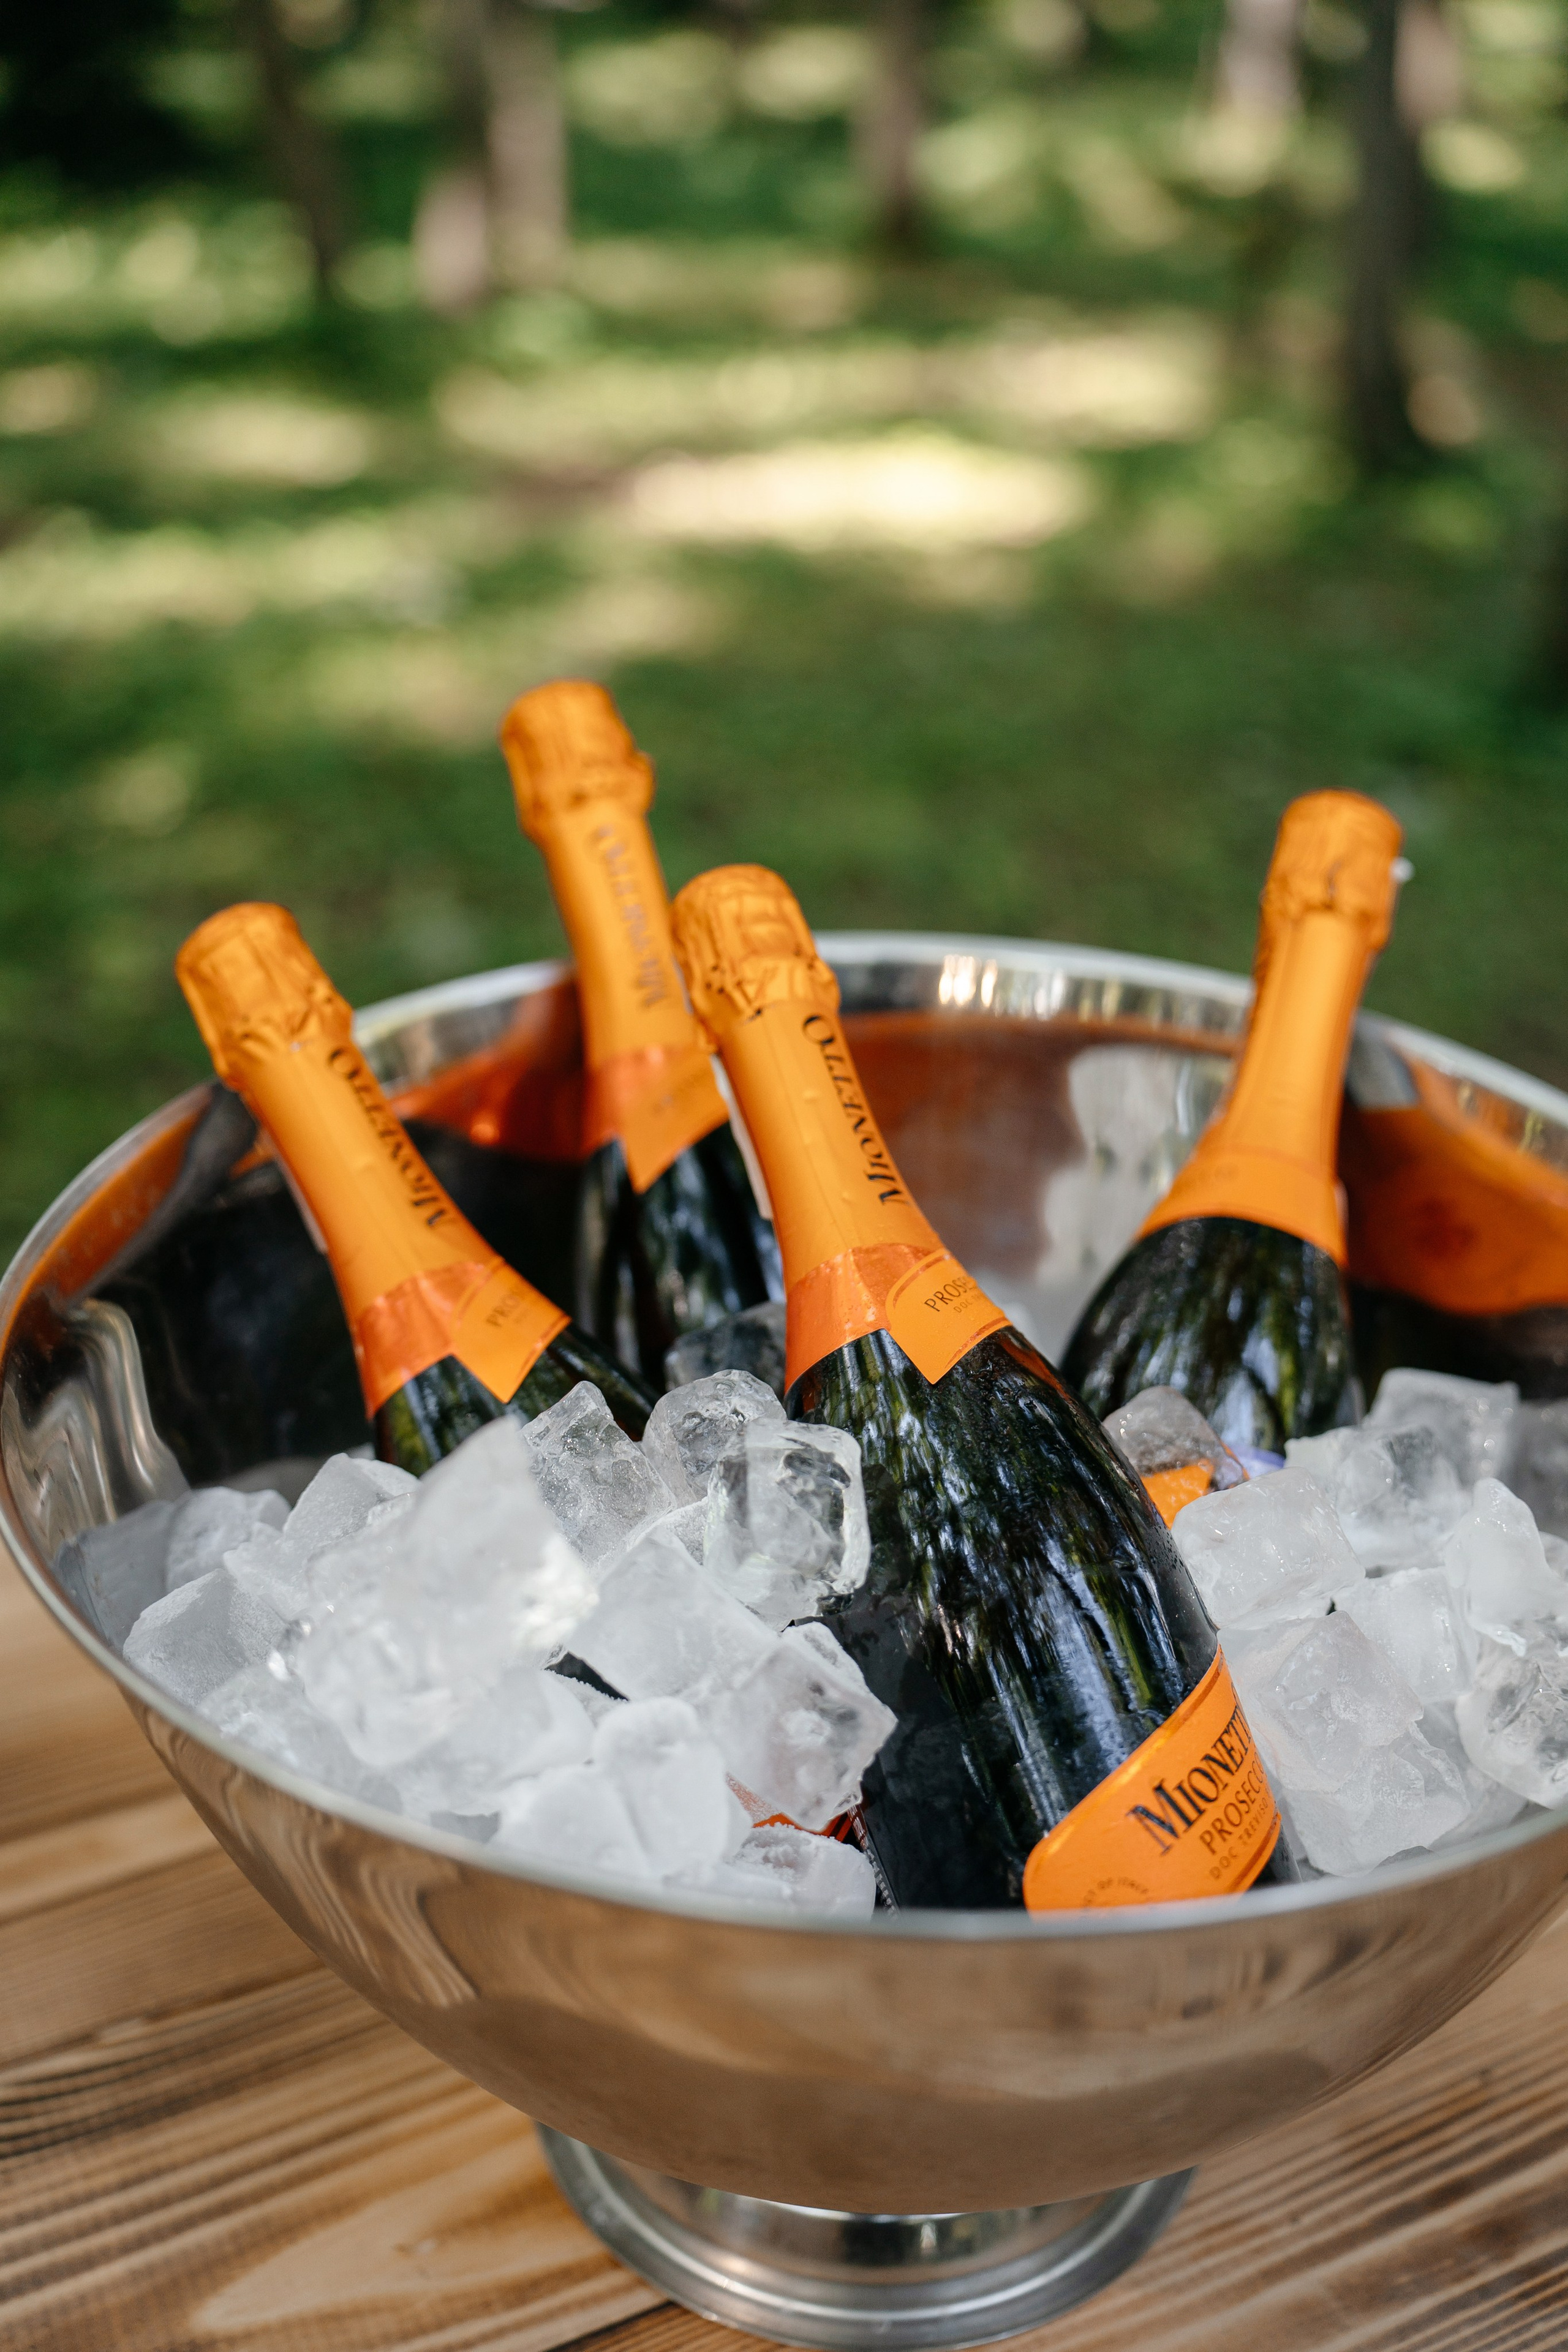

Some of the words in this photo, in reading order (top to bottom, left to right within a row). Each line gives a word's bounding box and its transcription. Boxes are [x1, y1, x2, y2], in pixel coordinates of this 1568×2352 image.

[801, 1013, 910, 1207] MIONETTO
[1125, 1681, 1252, 1856] MIONETTO
[1199, 1751, 1264, 1855] PROSECCO
[1209, 1845, 1238, 1880] DOC
